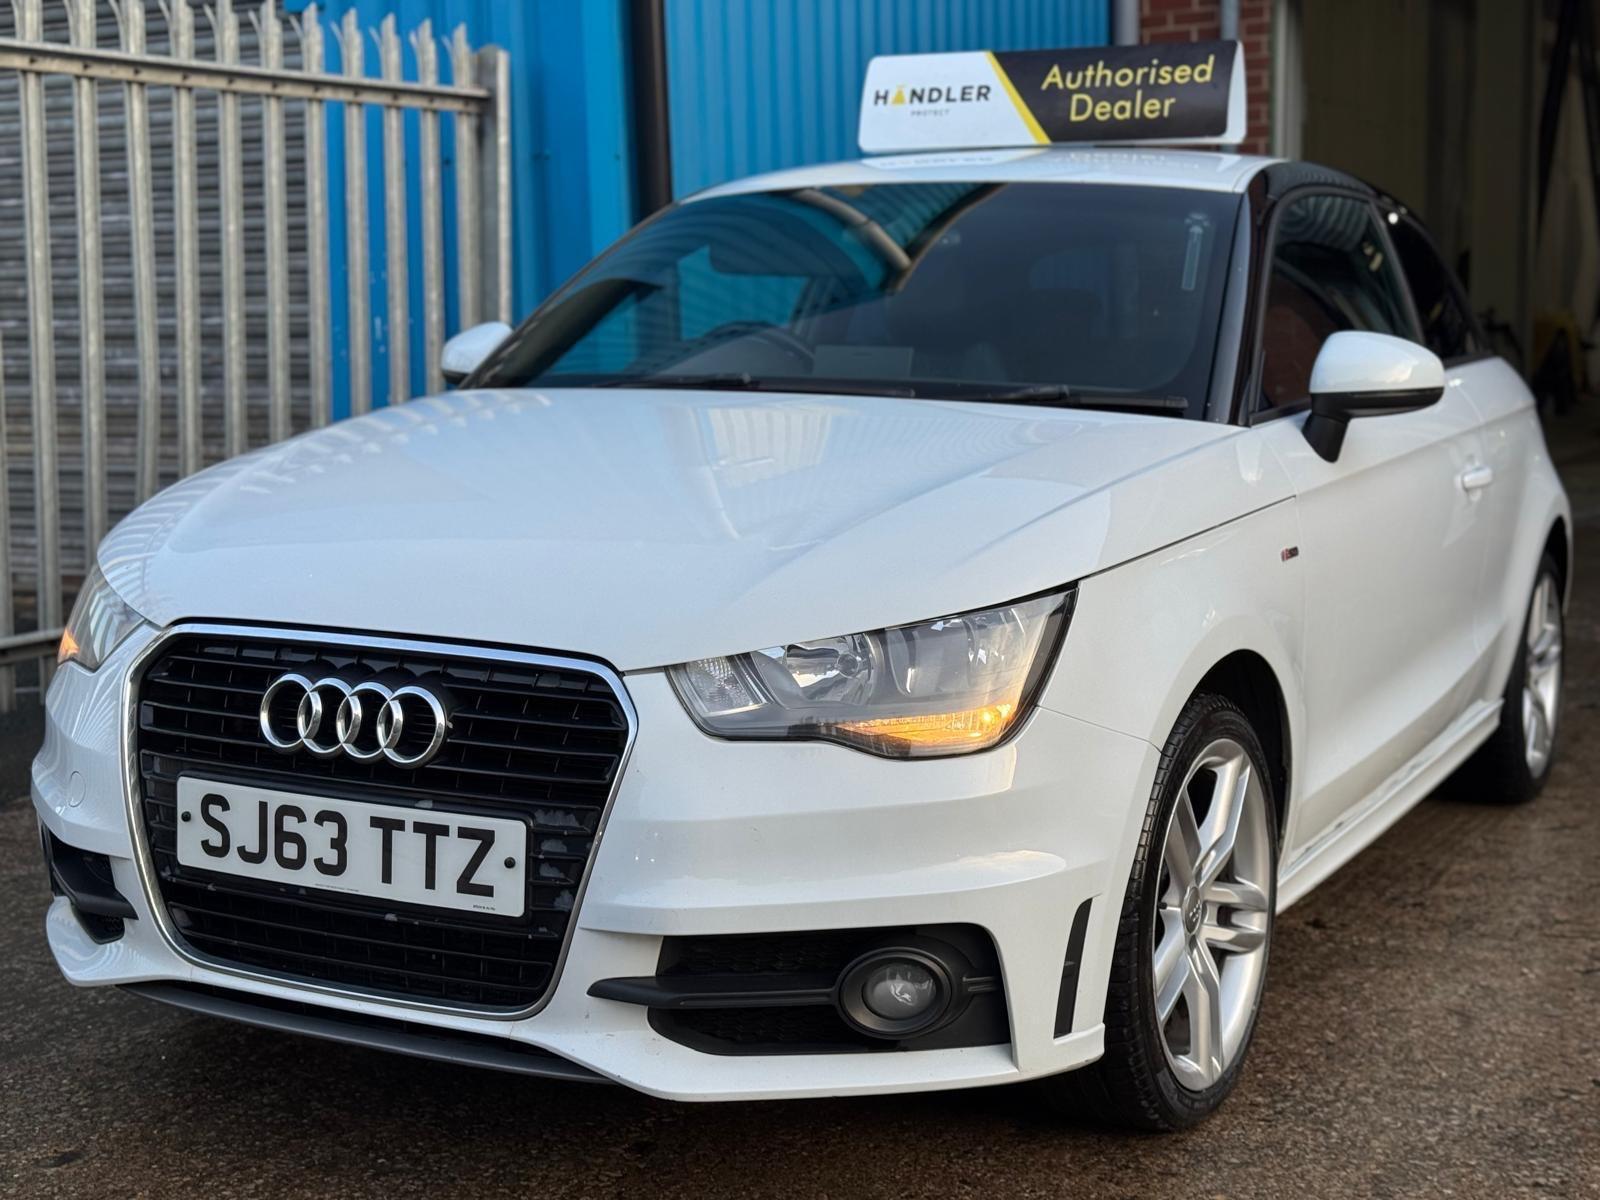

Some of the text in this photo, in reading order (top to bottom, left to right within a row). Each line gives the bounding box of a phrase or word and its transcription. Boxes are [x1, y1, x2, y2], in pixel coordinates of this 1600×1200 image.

[1041, 55, 1215, 91] Authorised
[875, 84, 991, 106] HANDLER
[1069, 90, 1176, 122] Dealer
[200, 793, 496, 898] SJ63 TTZ
